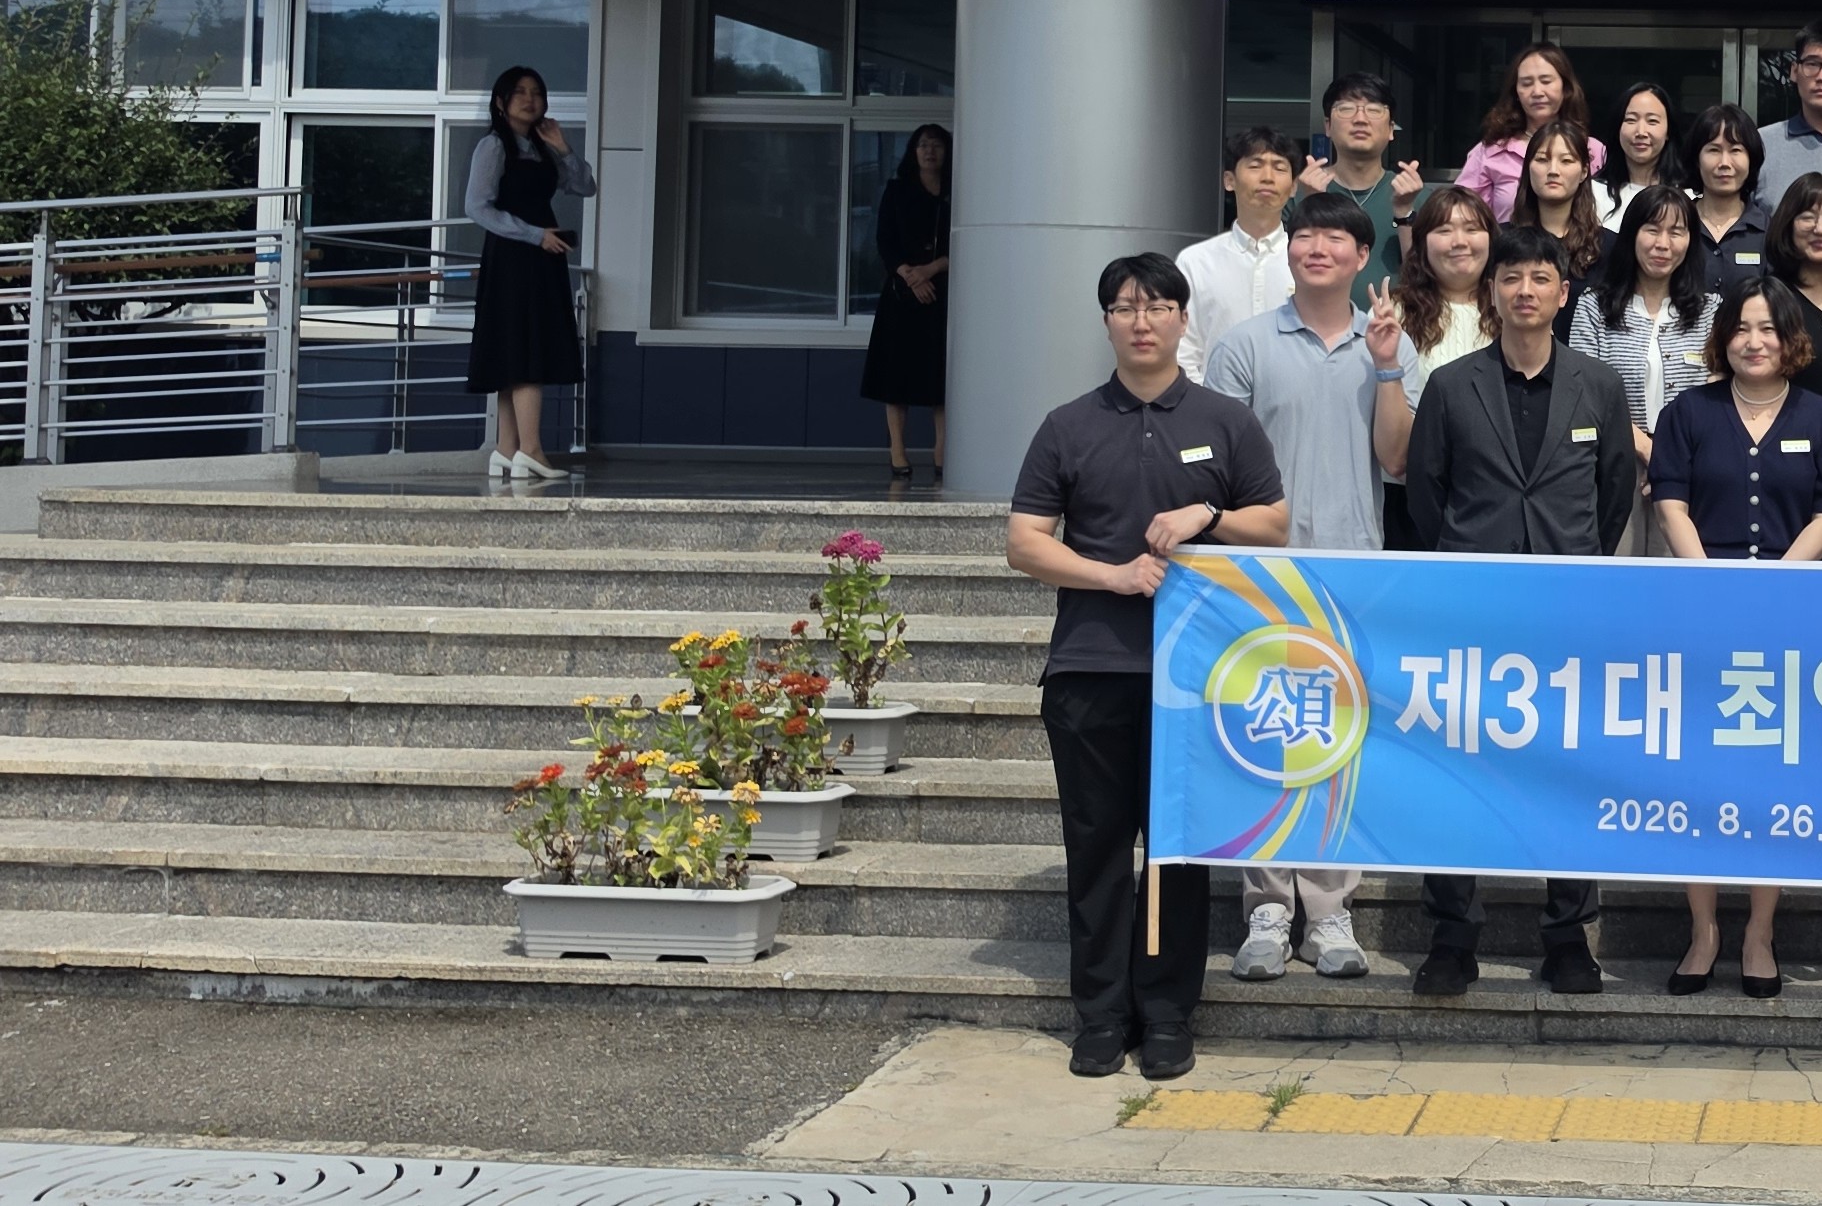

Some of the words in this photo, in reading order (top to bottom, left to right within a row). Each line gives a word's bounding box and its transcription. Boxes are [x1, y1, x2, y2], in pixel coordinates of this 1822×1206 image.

[1246, 666, 1337, 747] 頌
[1395, 646, 1683, 761] 제31대
[1597, 797, 1701, 838] 2026.
[1718, 802, 1752, 839] 8.
